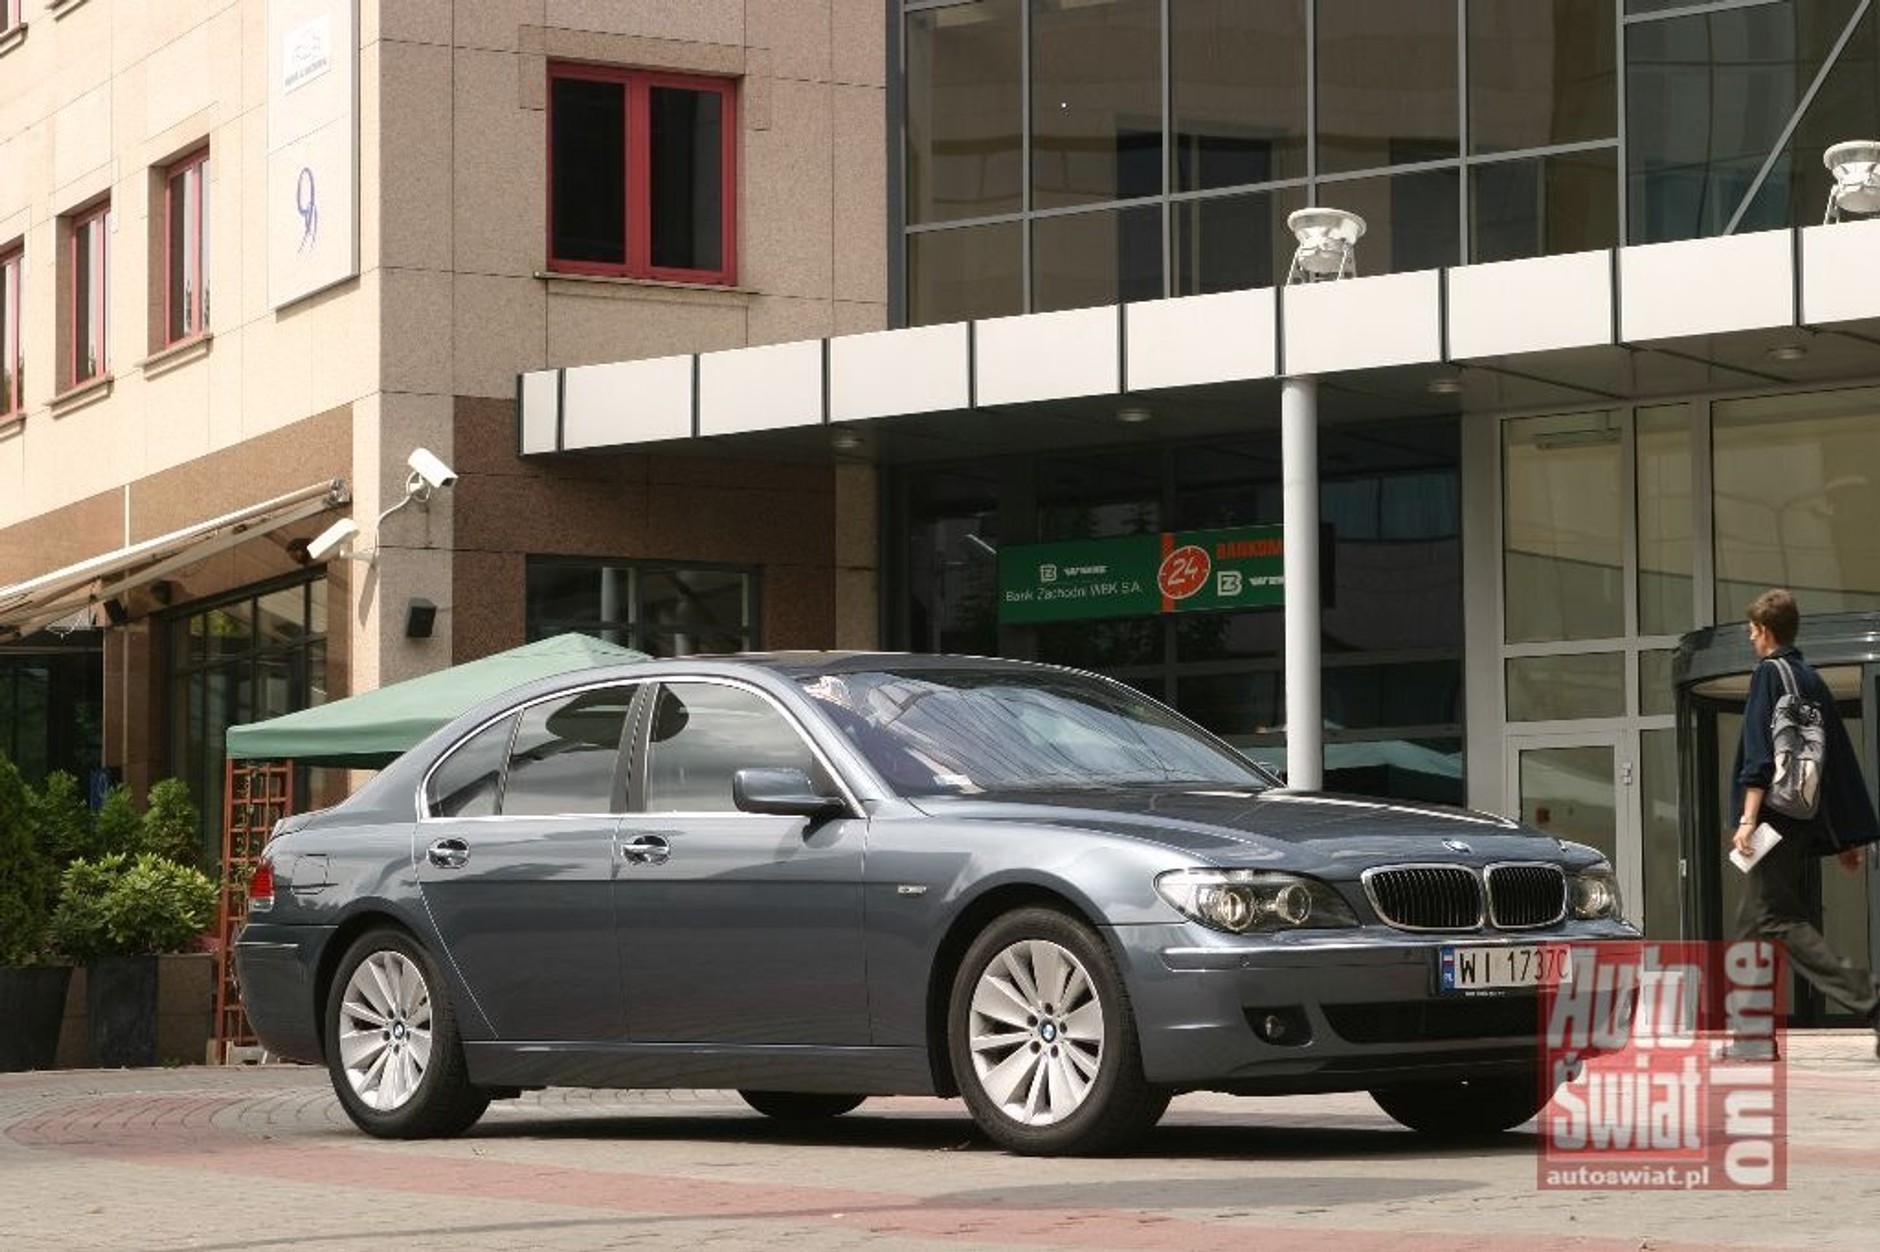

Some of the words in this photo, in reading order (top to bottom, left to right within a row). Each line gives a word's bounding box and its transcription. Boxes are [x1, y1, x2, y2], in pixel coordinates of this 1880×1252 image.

[1168, 555, 1199, 586] 24
[1006, 589, 1034, 602] Bank
[1037, 584, 1088, 600] Zachodni
[1090, 581, 1119, 596] WBK
[1460, 951, 1490, 983] WI
